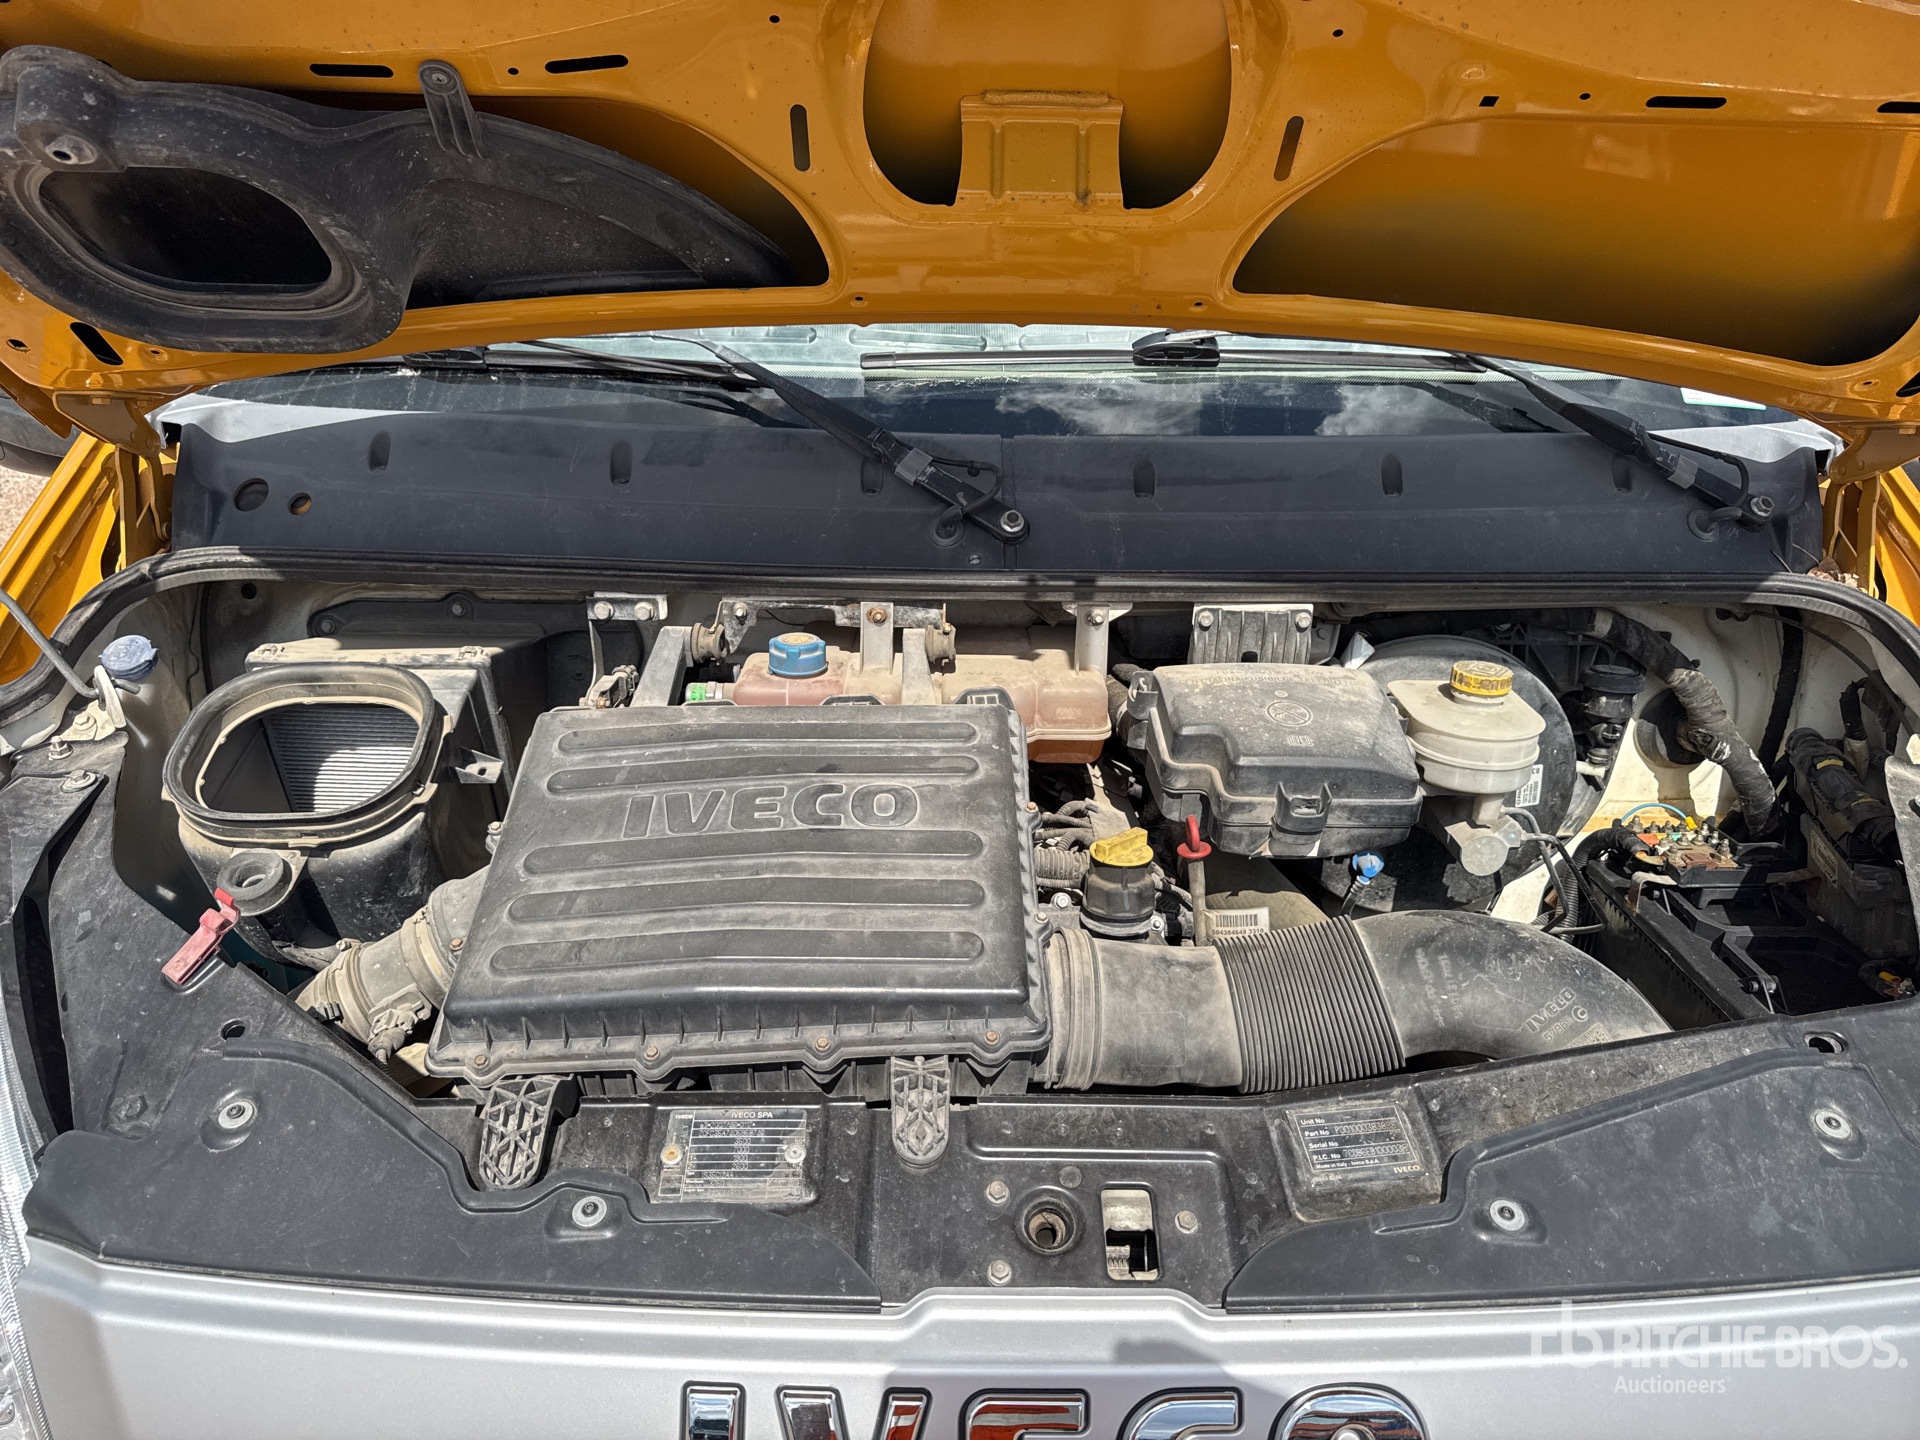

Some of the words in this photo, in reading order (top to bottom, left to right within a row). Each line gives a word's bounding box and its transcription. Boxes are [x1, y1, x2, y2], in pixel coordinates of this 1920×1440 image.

[622, 783, 919, 840] IVECO
[1525, 986, 1576, 1034] IVECO
[731, 1111, 756, 1119] IVECO
[757, 1111, 774, 1119] SPA
[1308, 1141, 1328, 1149] Serial
[1392, 1164, 1421, 1174] IVECO
